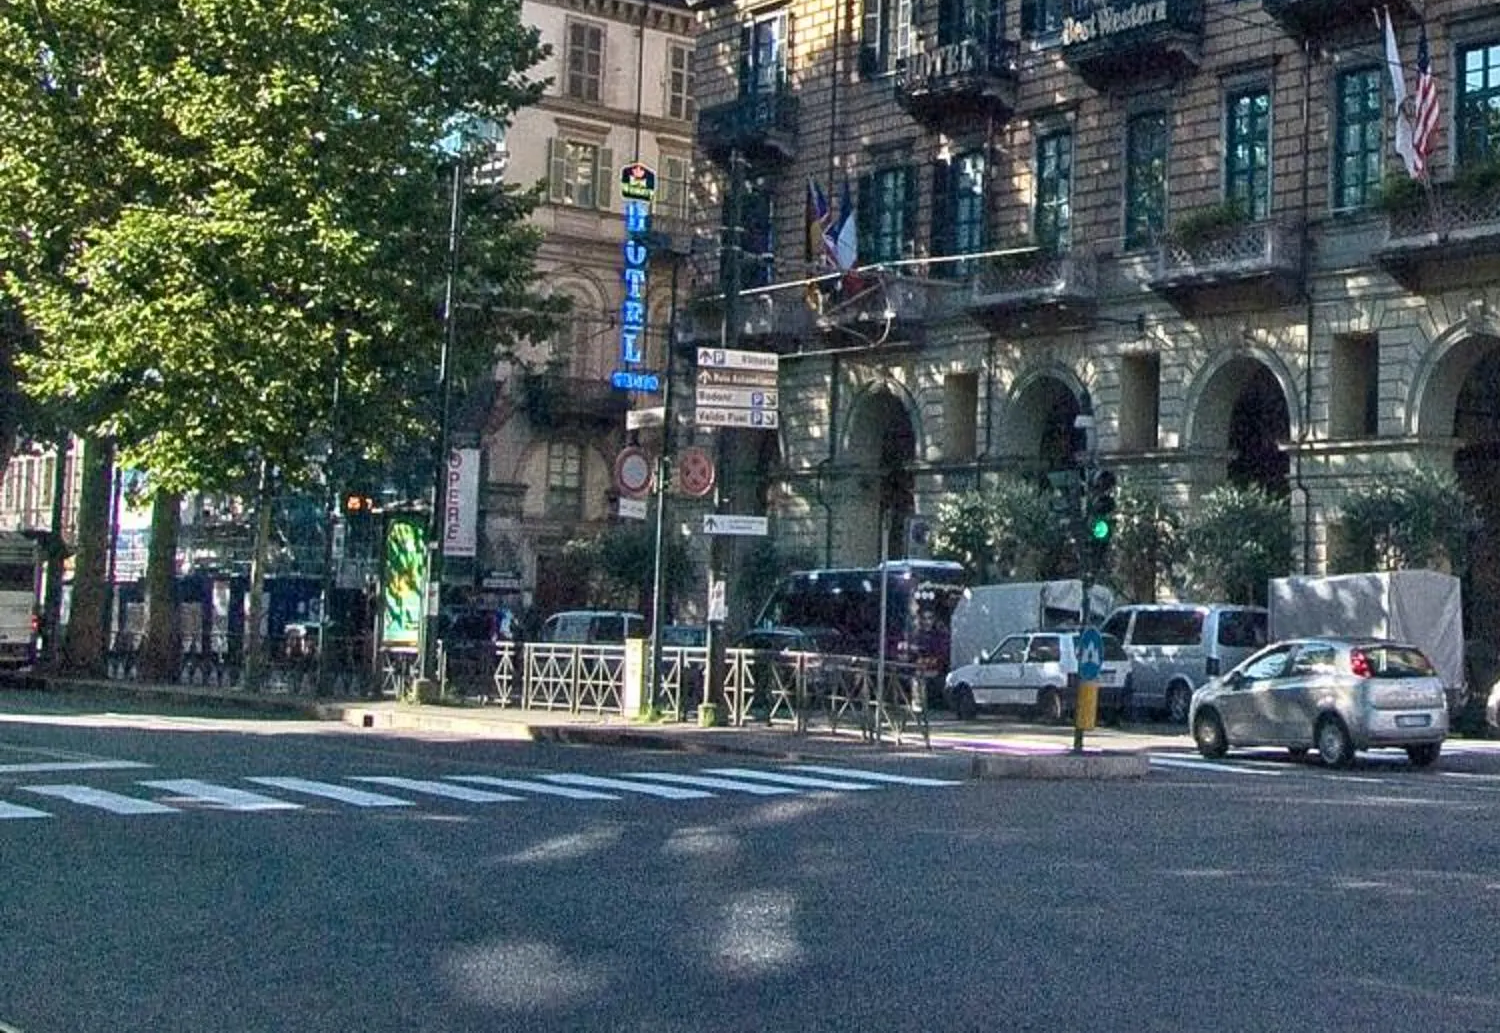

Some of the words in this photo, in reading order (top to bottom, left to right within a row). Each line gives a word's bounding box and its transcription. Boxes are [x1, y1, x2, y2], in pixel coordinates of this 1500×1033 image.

[1060, 16, 1097, 45] Best
[1097, 0, 1167, 36] Western
[622, 202, 648, 364] HOTEL
